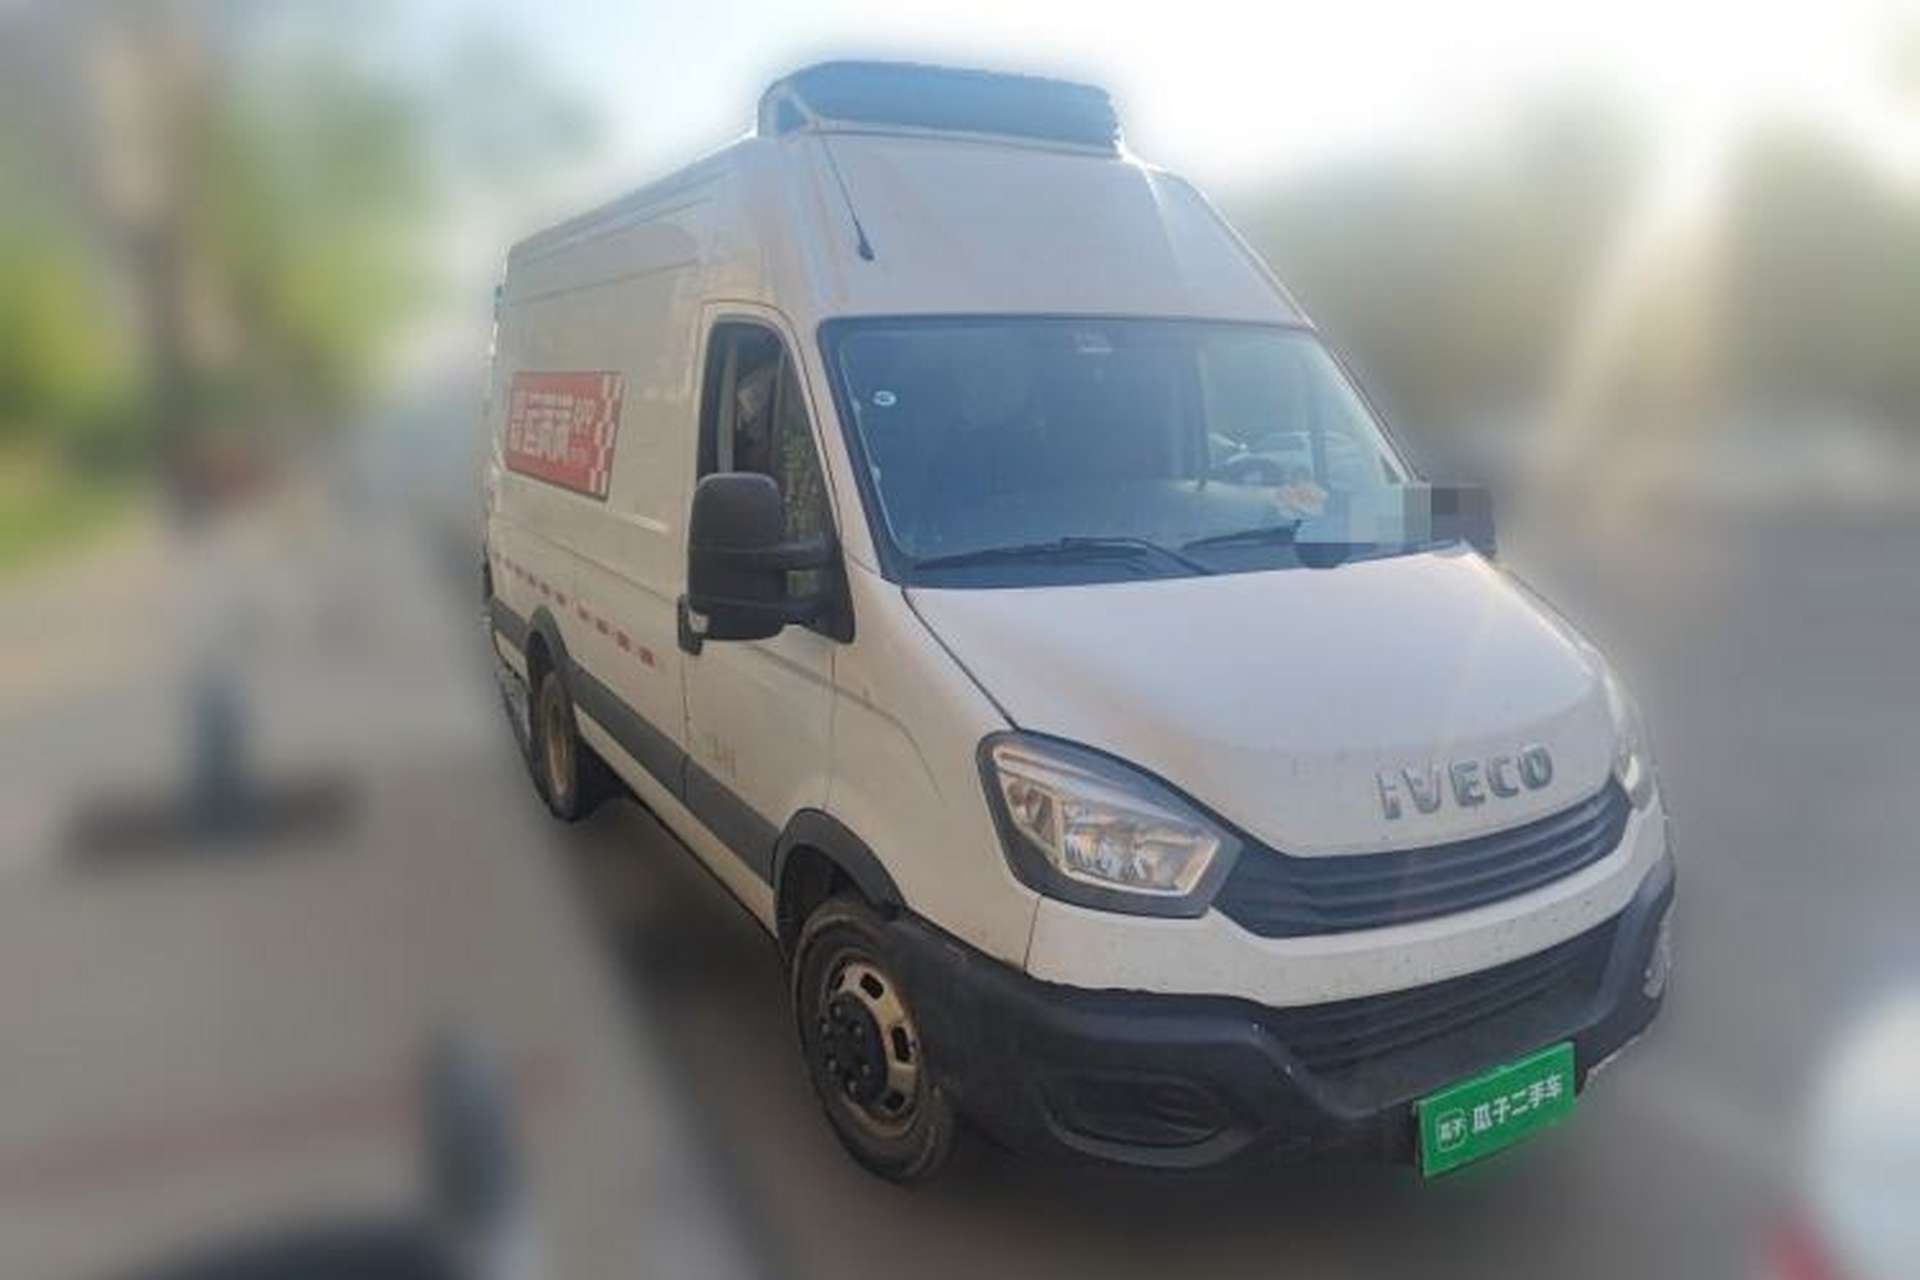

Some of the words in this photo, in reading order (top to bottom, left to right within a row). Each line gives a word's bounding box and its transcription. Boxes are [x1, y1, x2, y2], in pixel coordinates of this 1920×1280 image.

[1376, 744, 1553, 820] IVECO
[1472, 1074, 1563, 1134] 瓜子二手车
